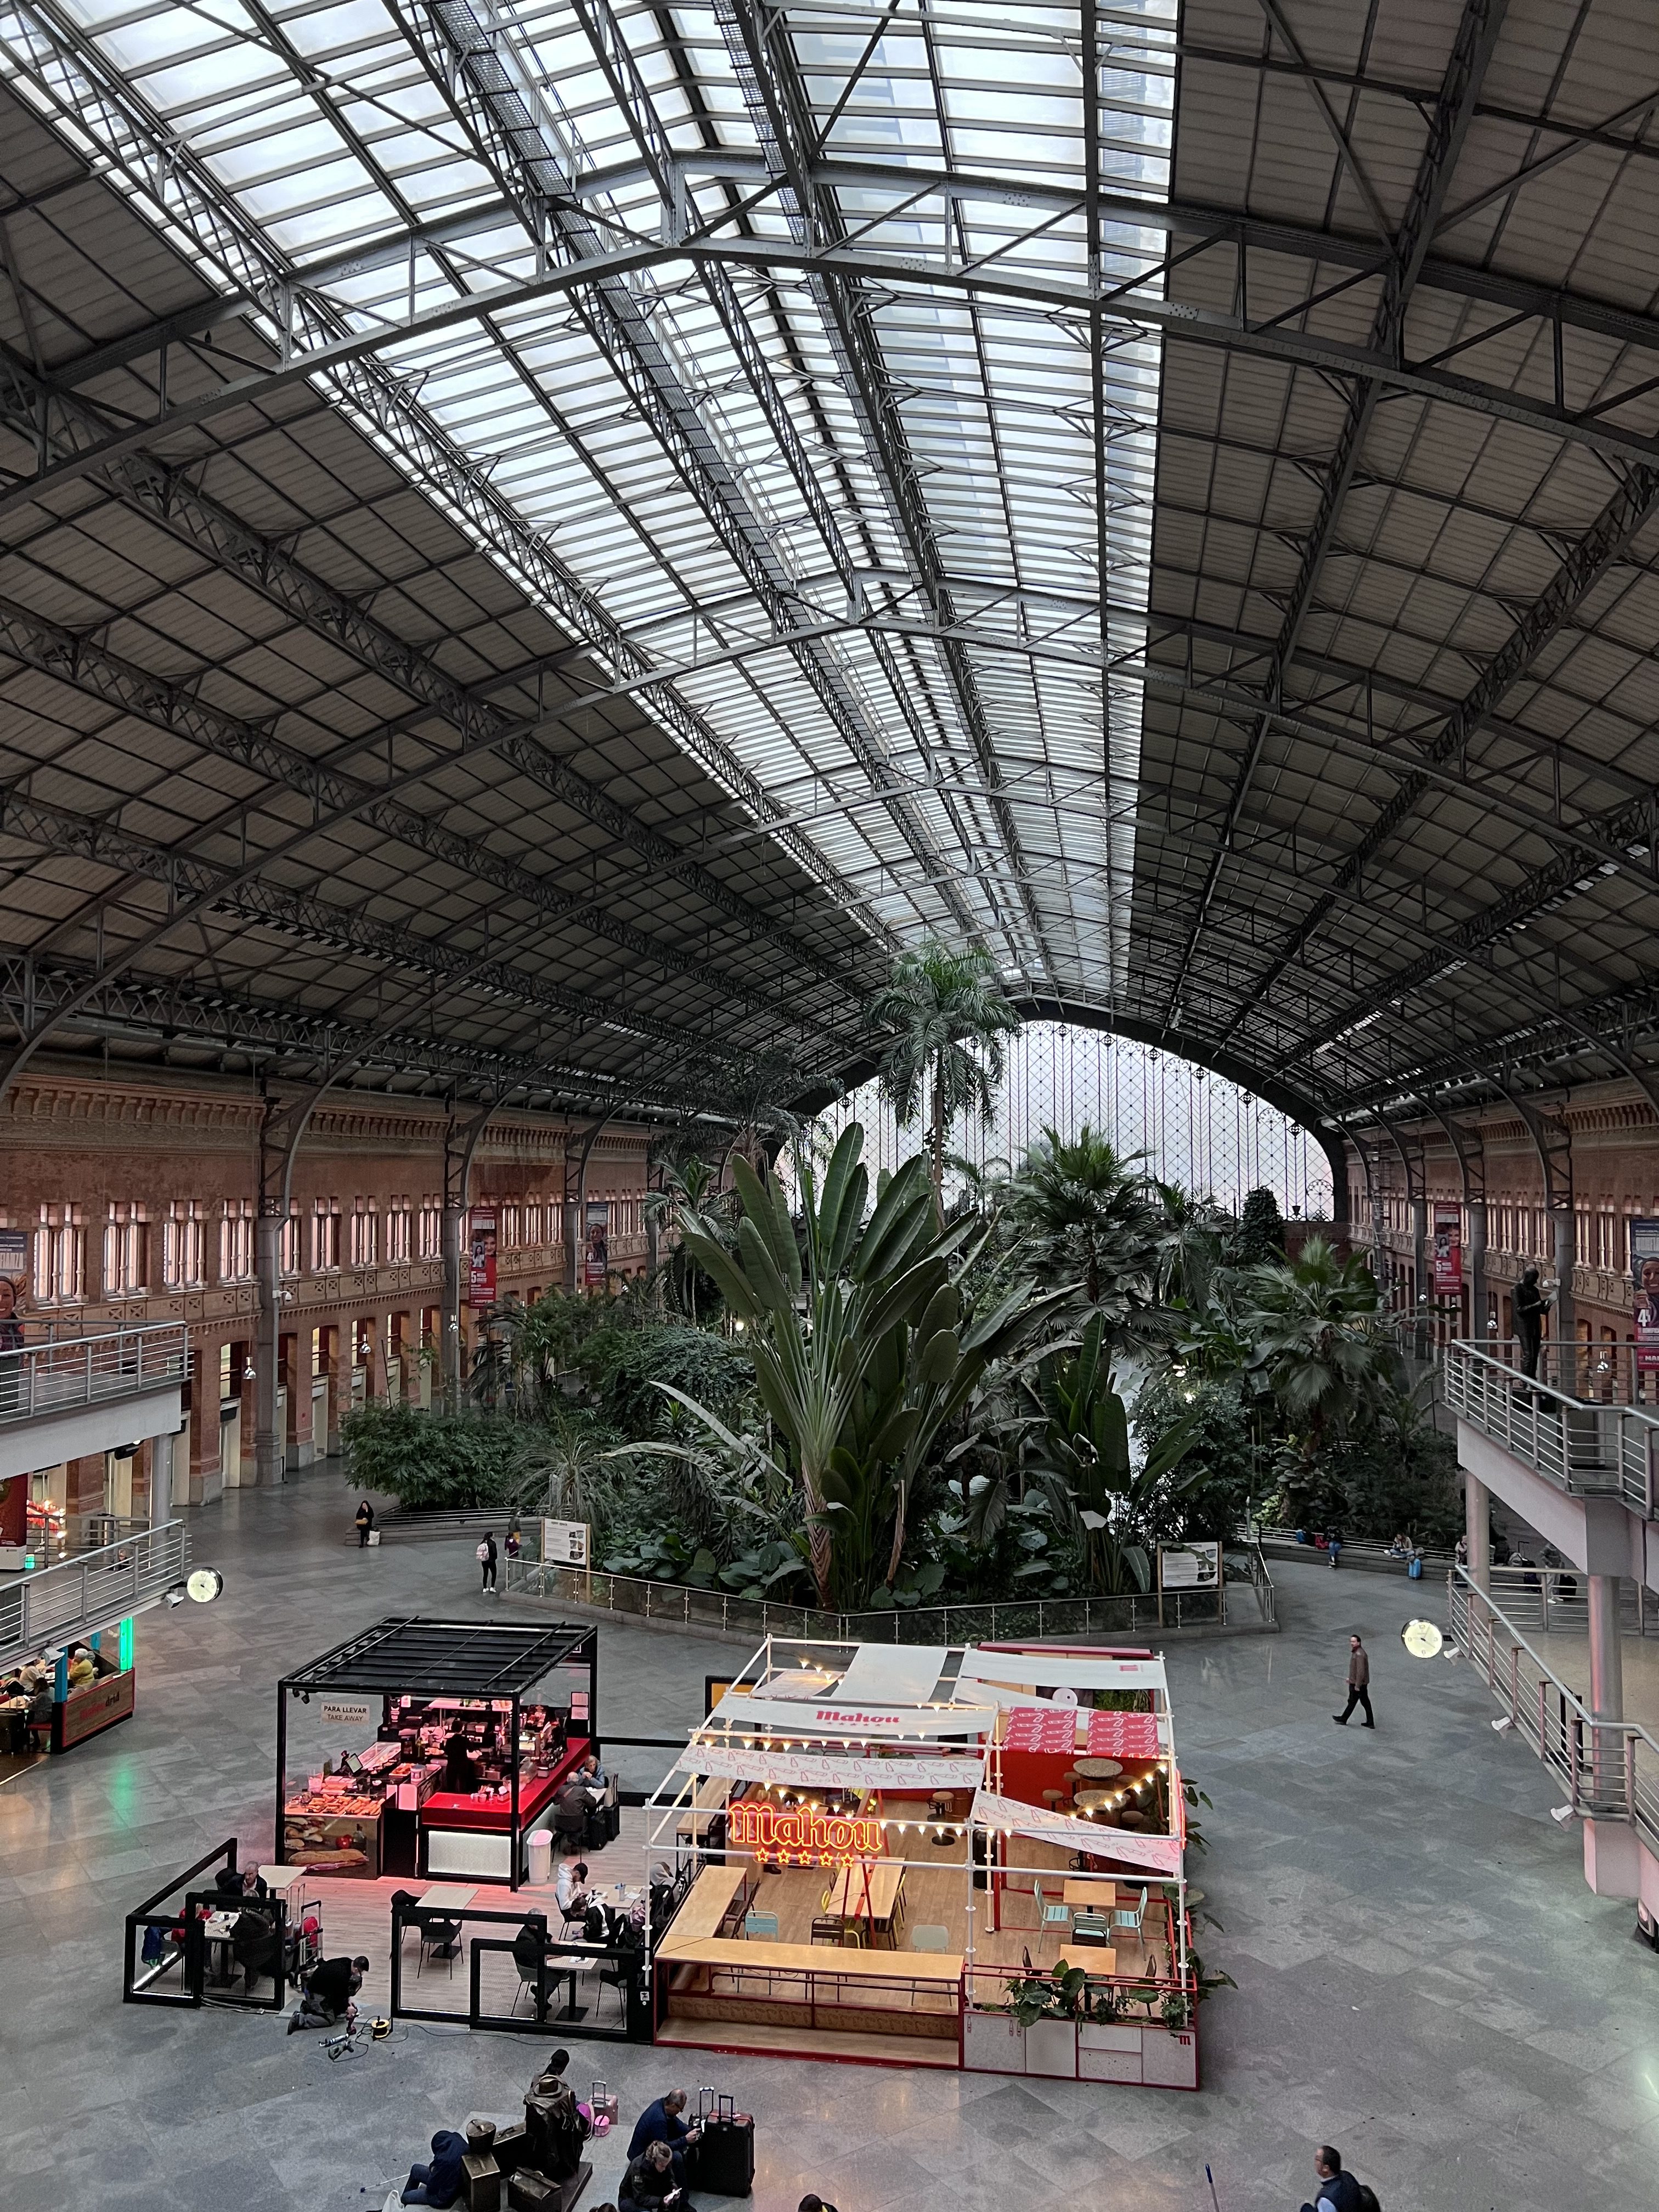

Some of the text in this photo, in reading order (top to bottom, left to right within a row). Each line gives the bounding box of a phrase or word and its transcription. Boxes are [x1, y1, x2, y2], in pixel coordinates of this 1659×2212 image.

[1436, 1260, 1441, 1271] 5
[471, 1271, 476, 1283] 5
[816, 1710, 900, 1723] Mahou
[729, 1802, 883, 1852] Mahou
